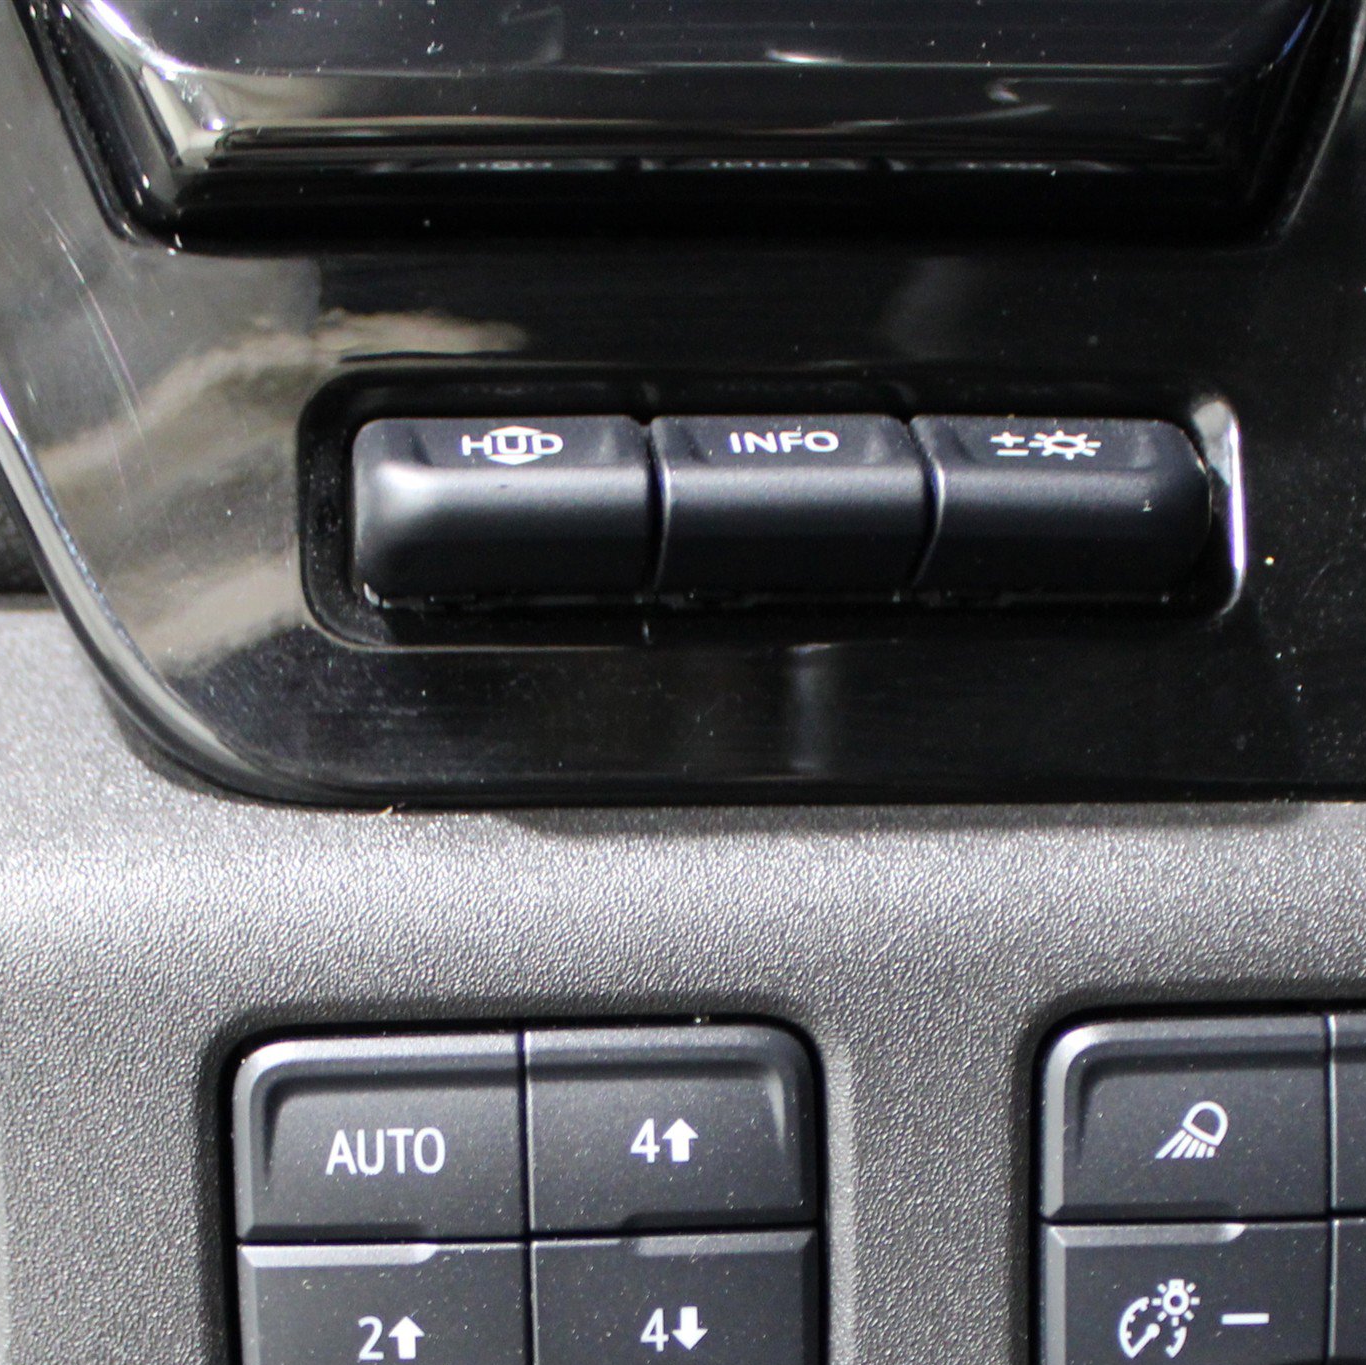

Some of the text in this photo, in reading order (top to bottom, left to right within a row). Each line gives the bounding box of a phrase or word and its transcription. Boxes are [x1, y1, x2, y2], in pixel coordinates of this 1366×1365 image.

[461, 433, 564, 456] HUD
[729, 430, 839, 454] INFO
[325, 1127, 446, 1176] AUTO
[630, 1118, 661, 1164] 4
[357, 1316, 385, 1361] 2
[640, 1308, 669, 1352] 4
